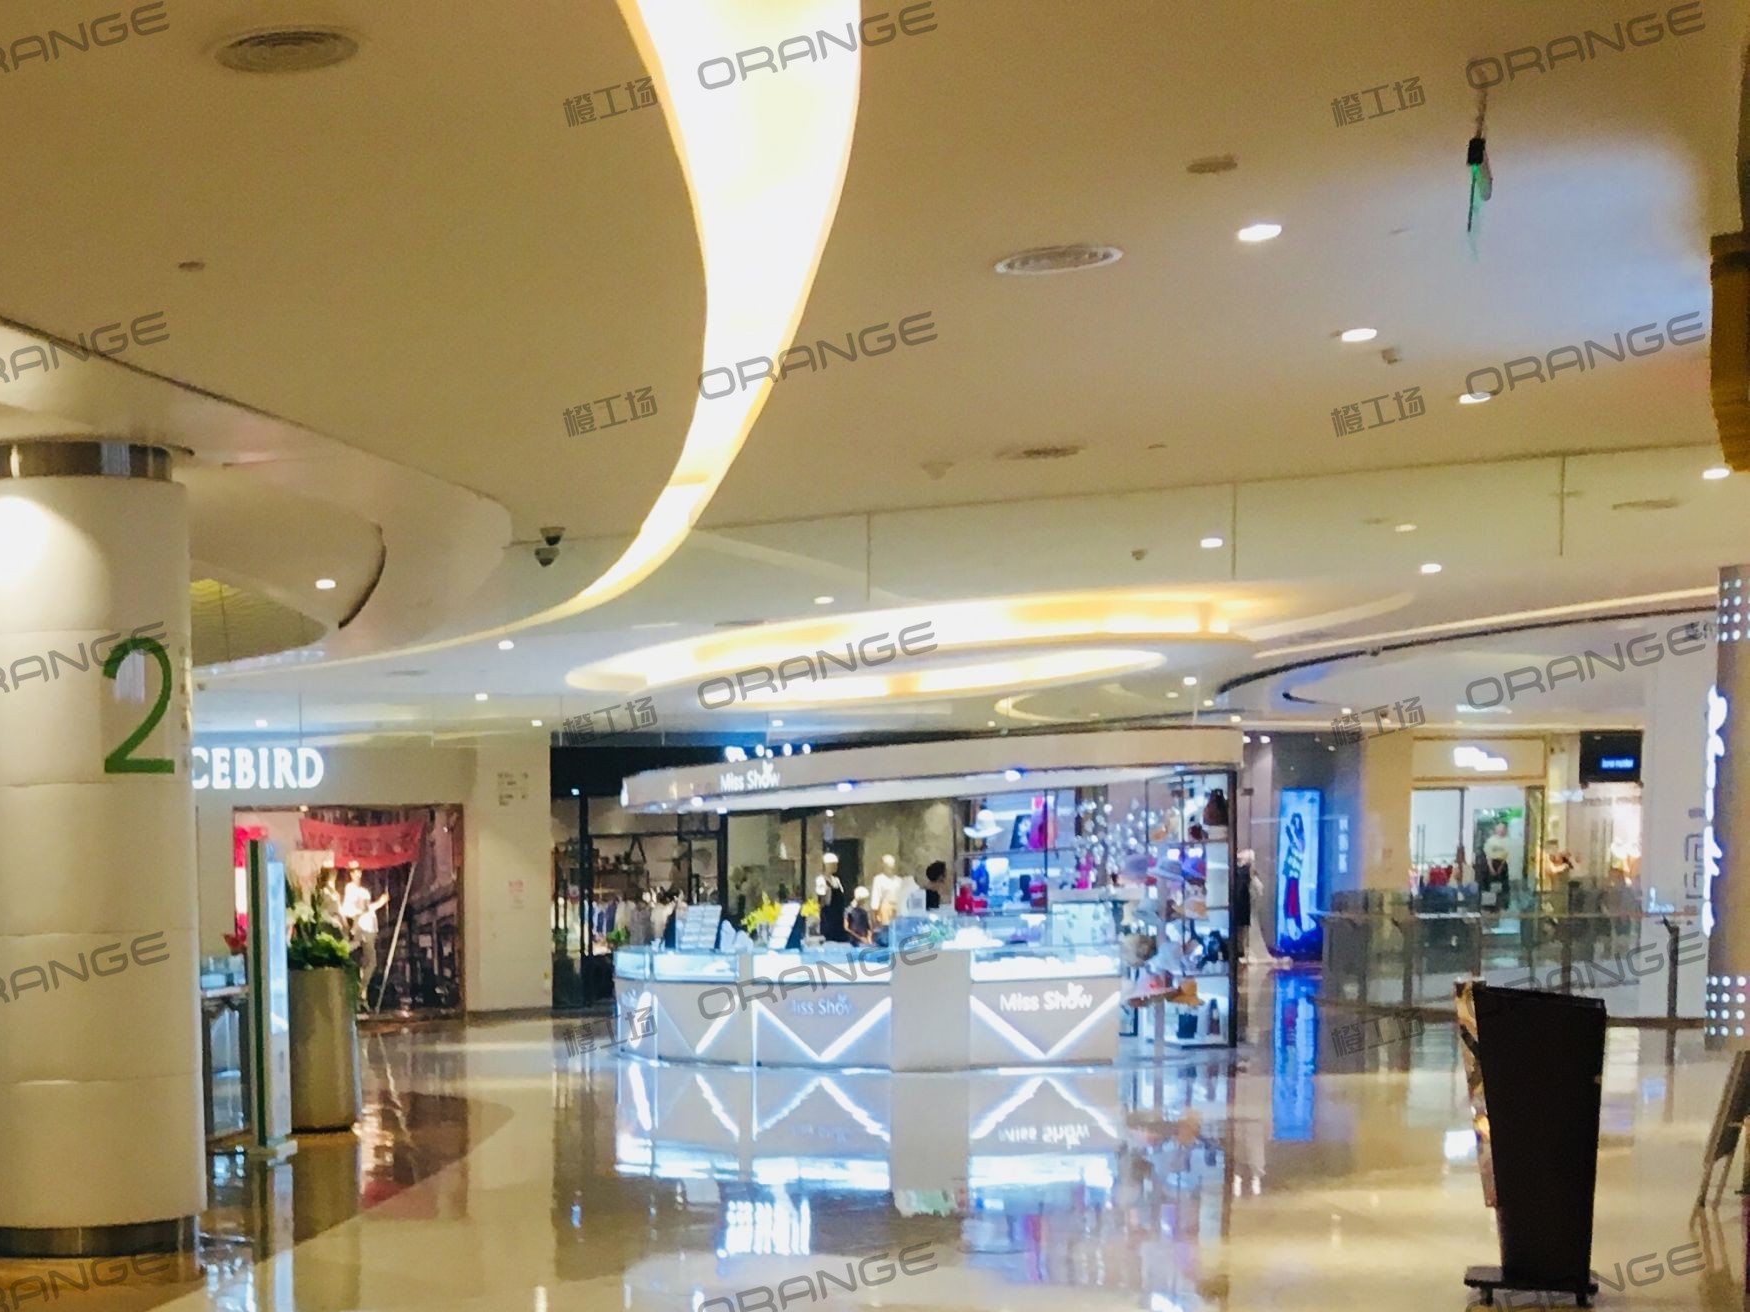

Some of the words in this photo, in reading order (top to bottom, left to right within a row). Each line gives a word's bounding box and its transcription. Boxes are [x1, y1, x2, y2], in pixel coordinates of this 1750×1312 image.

[103, 636, 175, 774] 2
[999, 993, 1040, 1012] Miss
[1043, 986, 1093, 1011] Show
